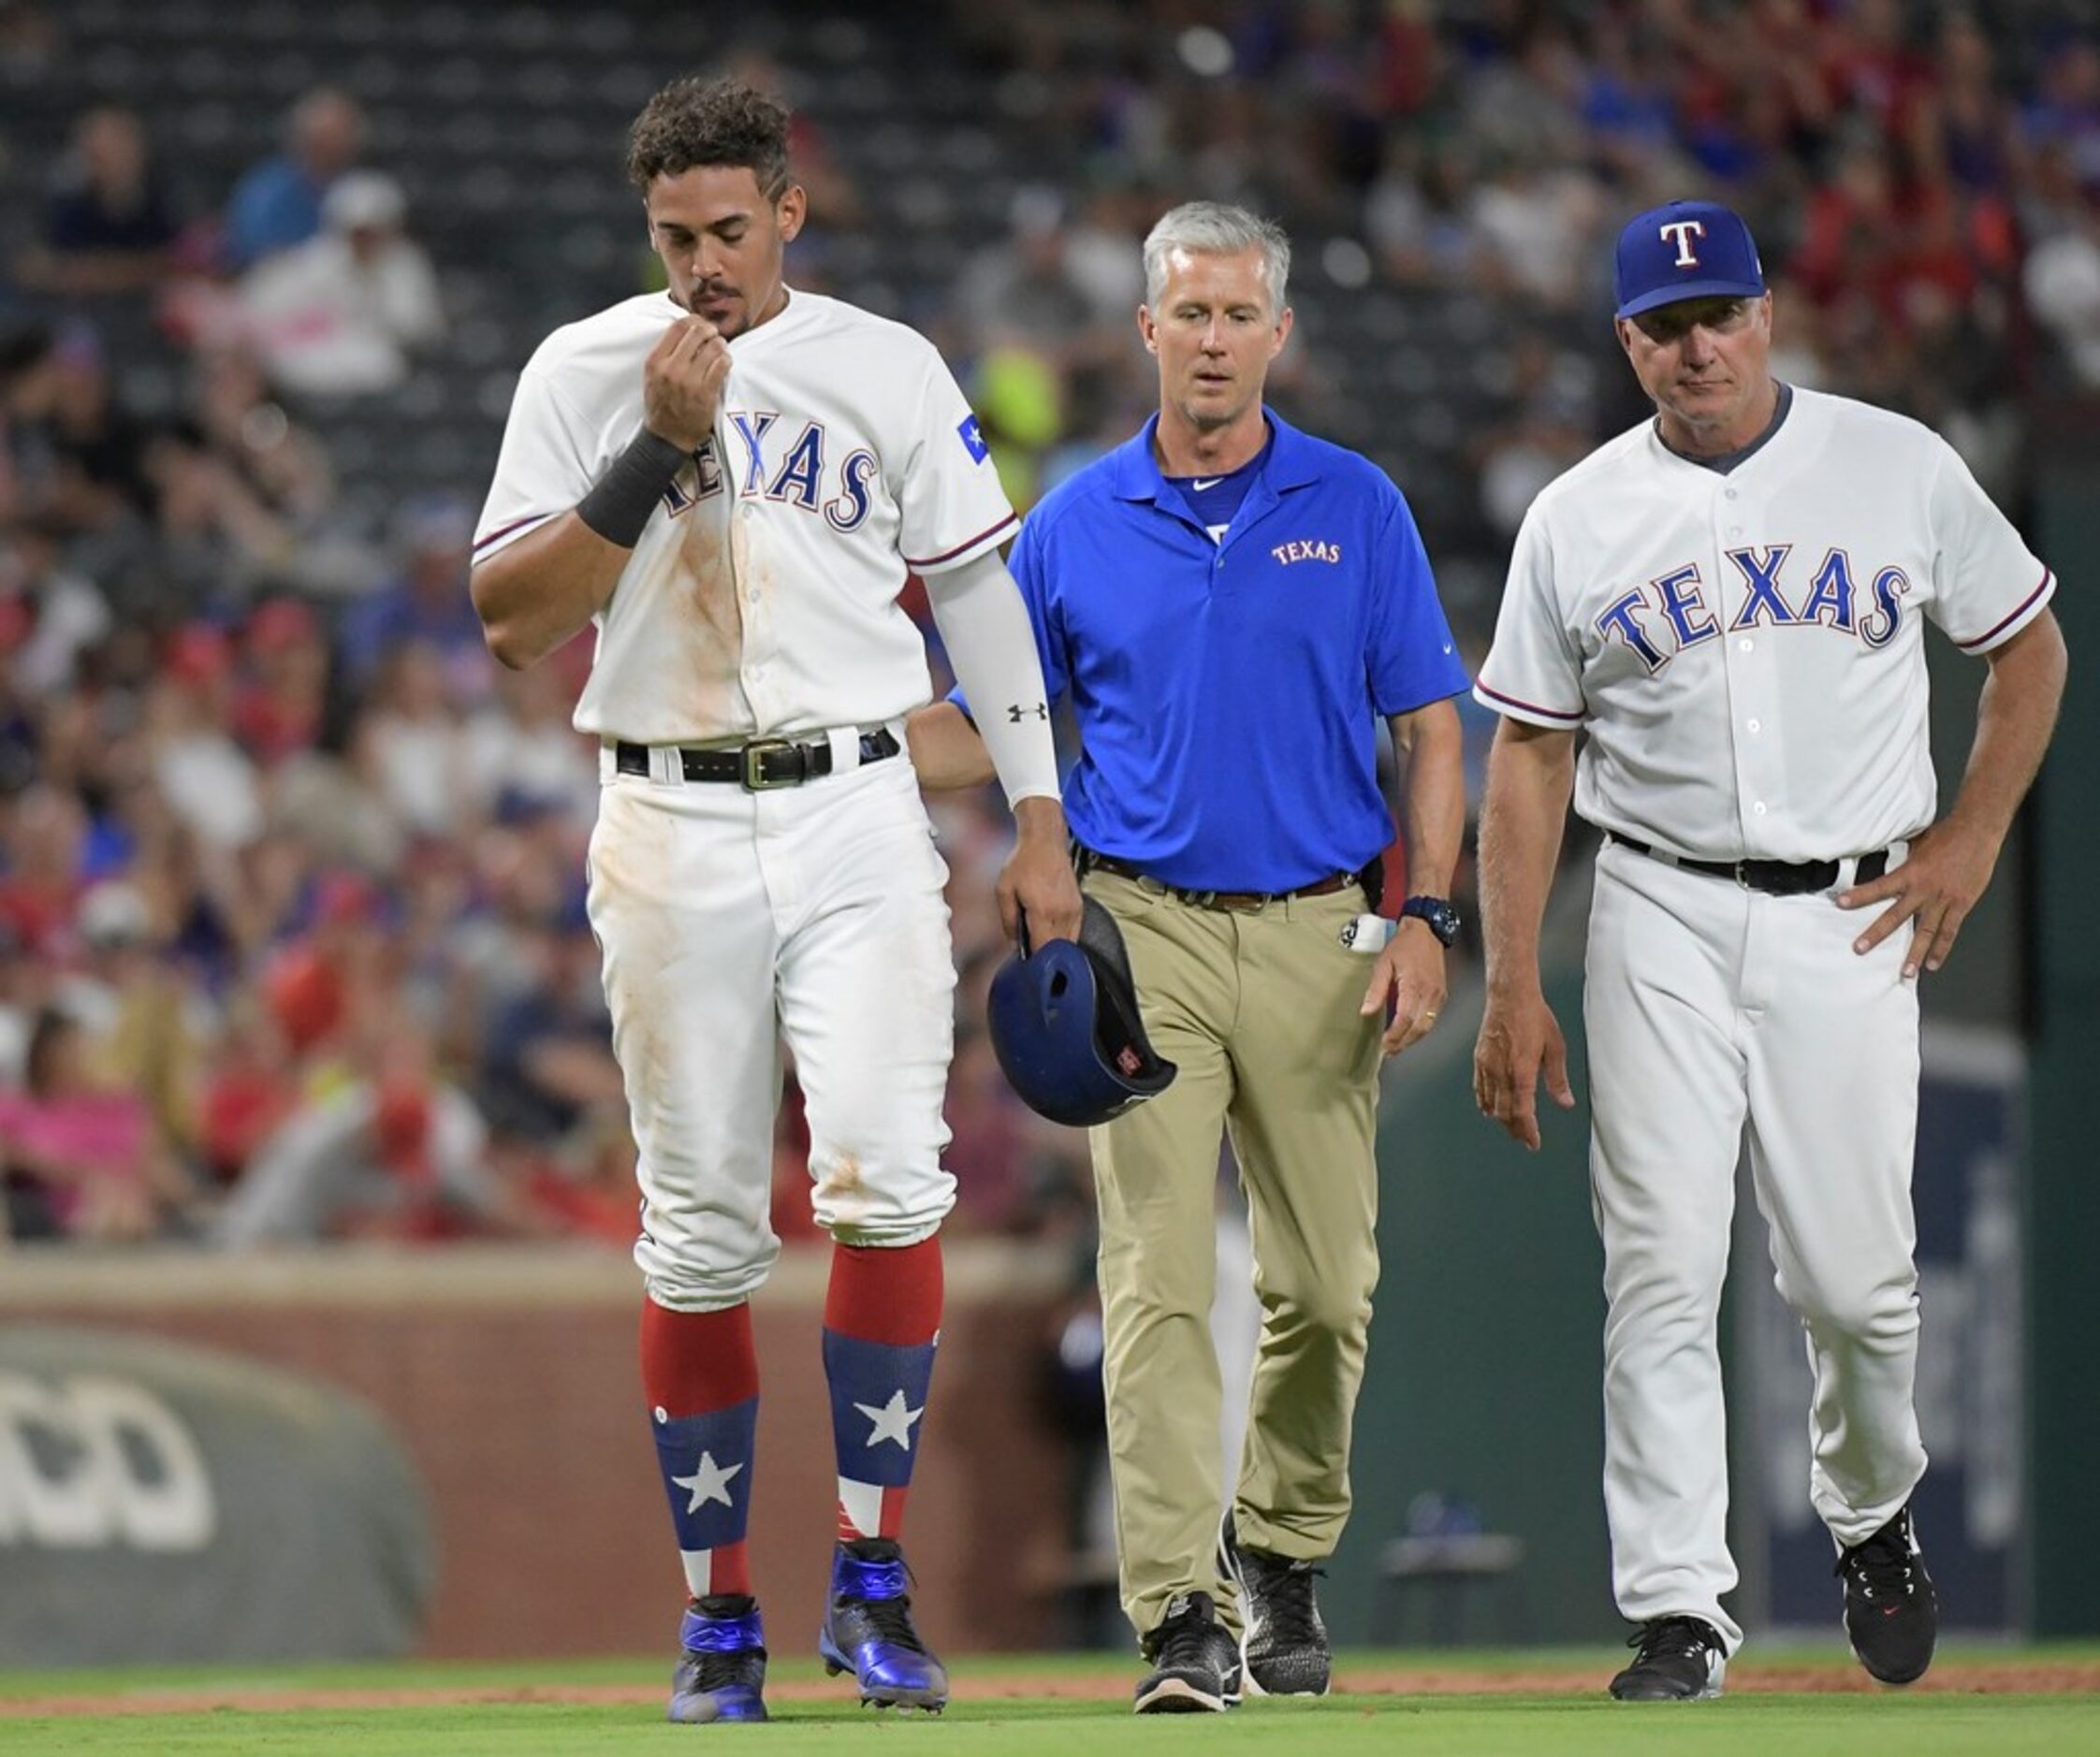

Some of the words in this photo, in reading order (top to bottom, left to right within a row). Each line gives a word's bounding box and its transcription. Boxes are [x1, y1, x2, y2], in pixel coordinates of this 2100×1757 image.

[1660, 221, 1705, 269] T
[1272, 540, 1340, 565] TEXAS
[1594, 544, 1911, 675] TEXAS
